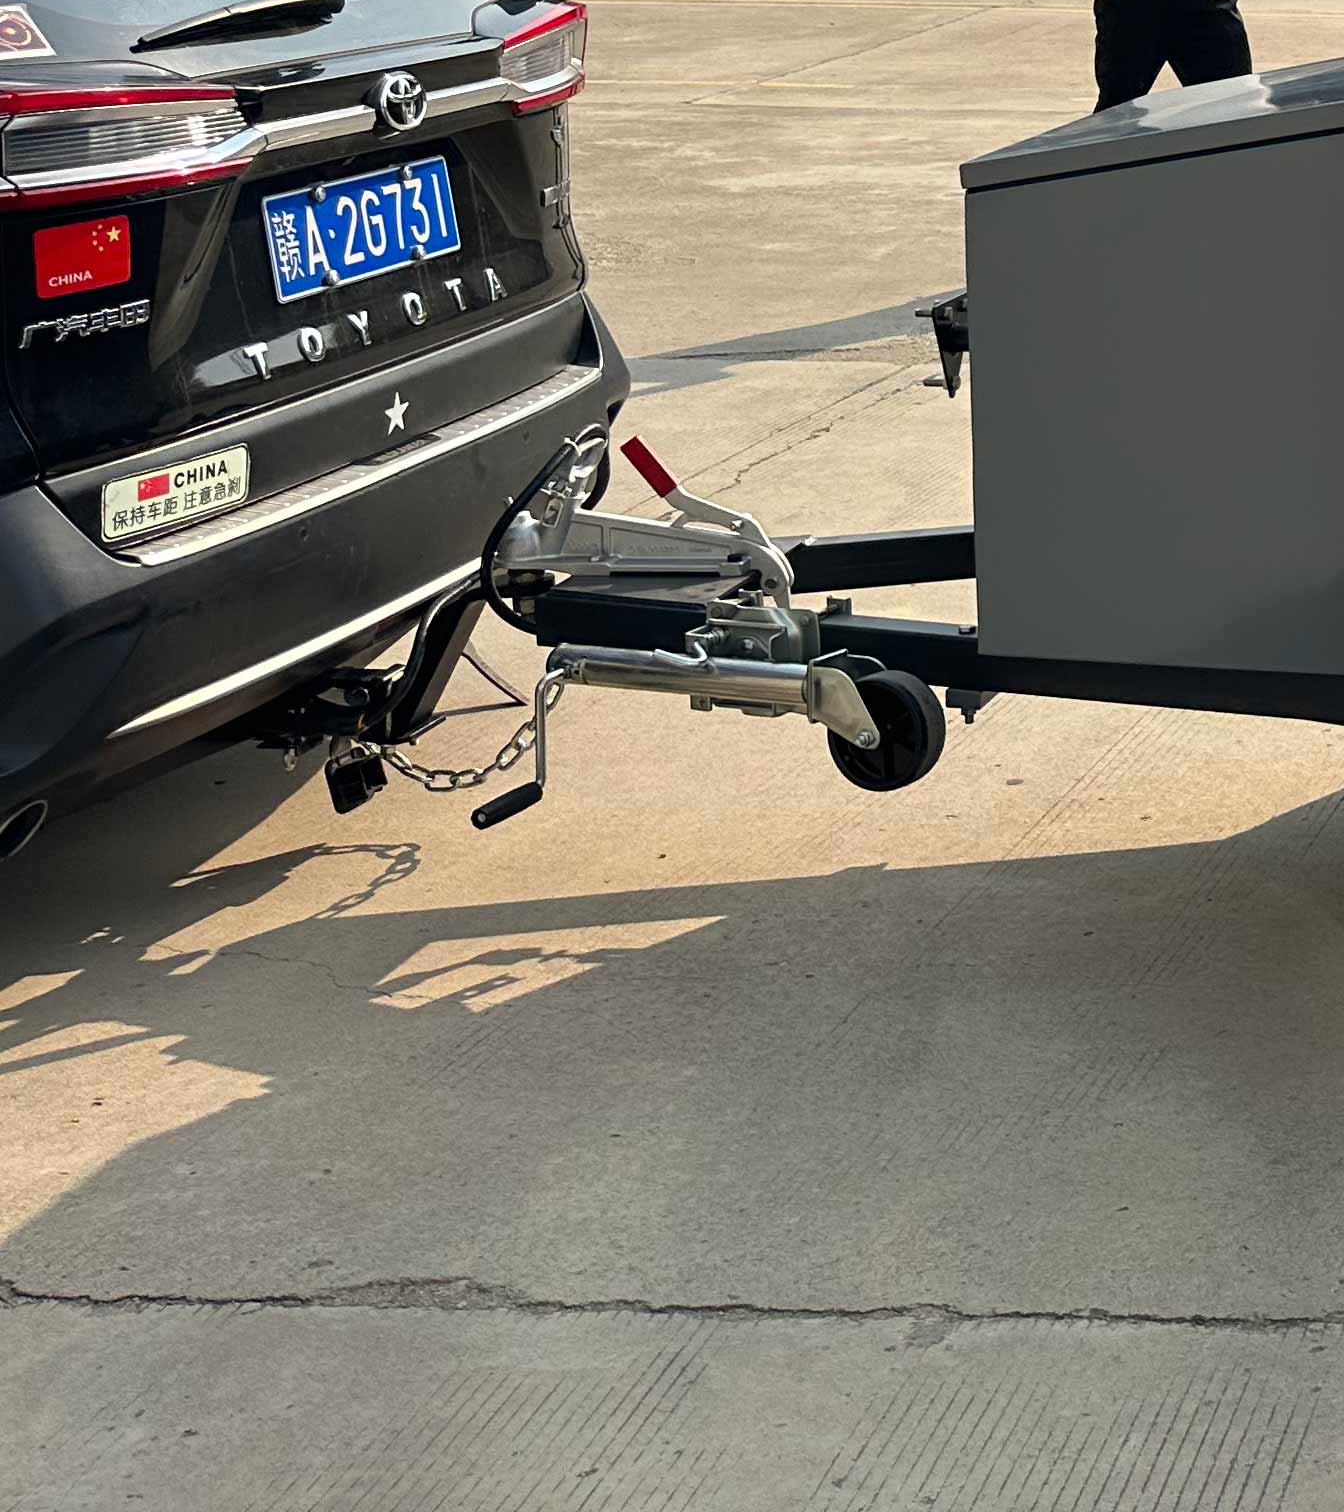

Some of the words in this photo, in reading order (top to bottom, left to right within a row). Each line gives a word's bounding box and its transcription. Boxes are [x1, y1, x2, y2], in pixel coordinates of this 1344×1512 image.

[48, 270, 93, 288] CHINA
[242, 267, 508, 381] TOYOTA
[173, 460, 228, 489] CHINA
[111, 496, 179, 532] 保持车距
[183, 475, 242, 512] 注意急刹
